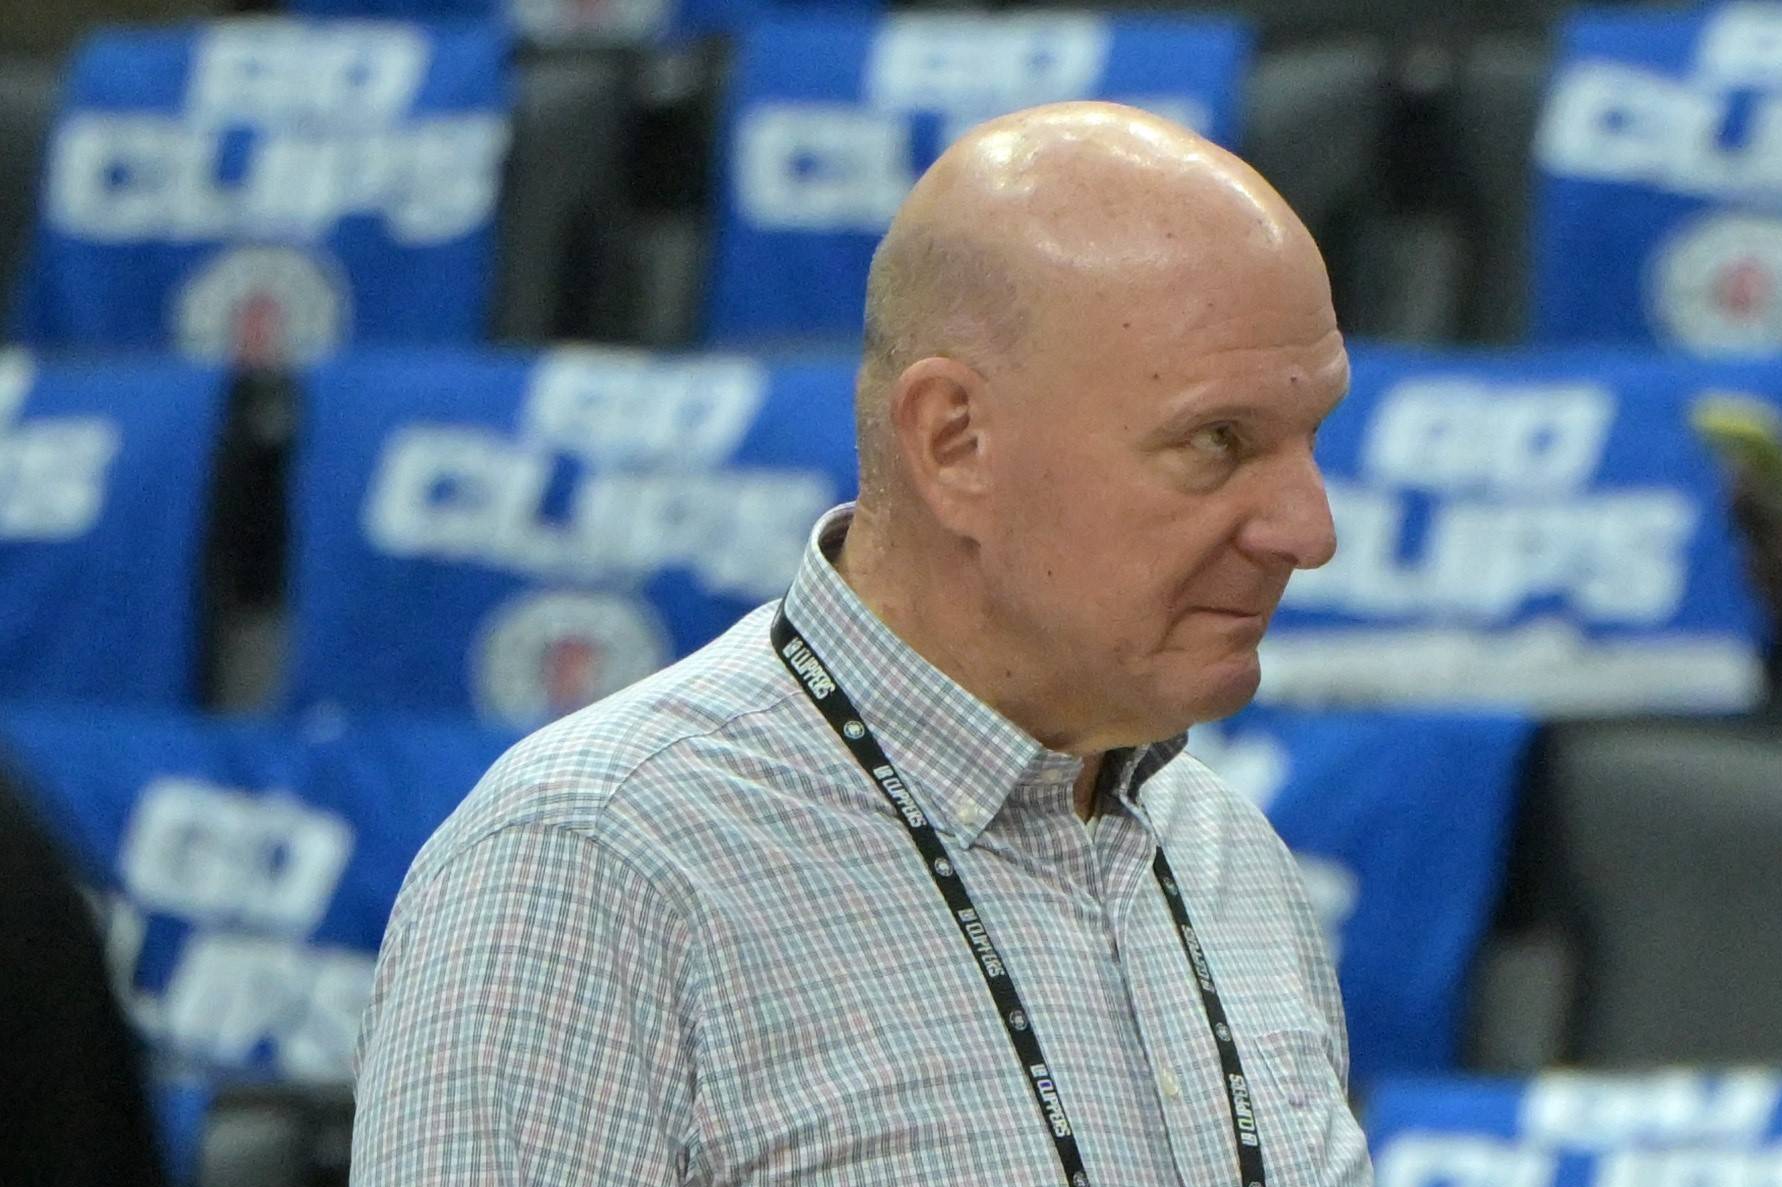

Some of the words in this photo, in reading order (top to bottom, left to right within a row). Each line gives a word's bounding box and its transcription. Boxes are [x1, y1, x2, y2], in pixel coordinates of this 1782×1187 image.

[790, 646, 836, 700] CLIPPERS
[882, 777, 927, 828] CLIPPERS
[1036, 1078, 1071, 1139] CLIPPERS
[1229, 1073, 1256, 1133] CLIPPERS
